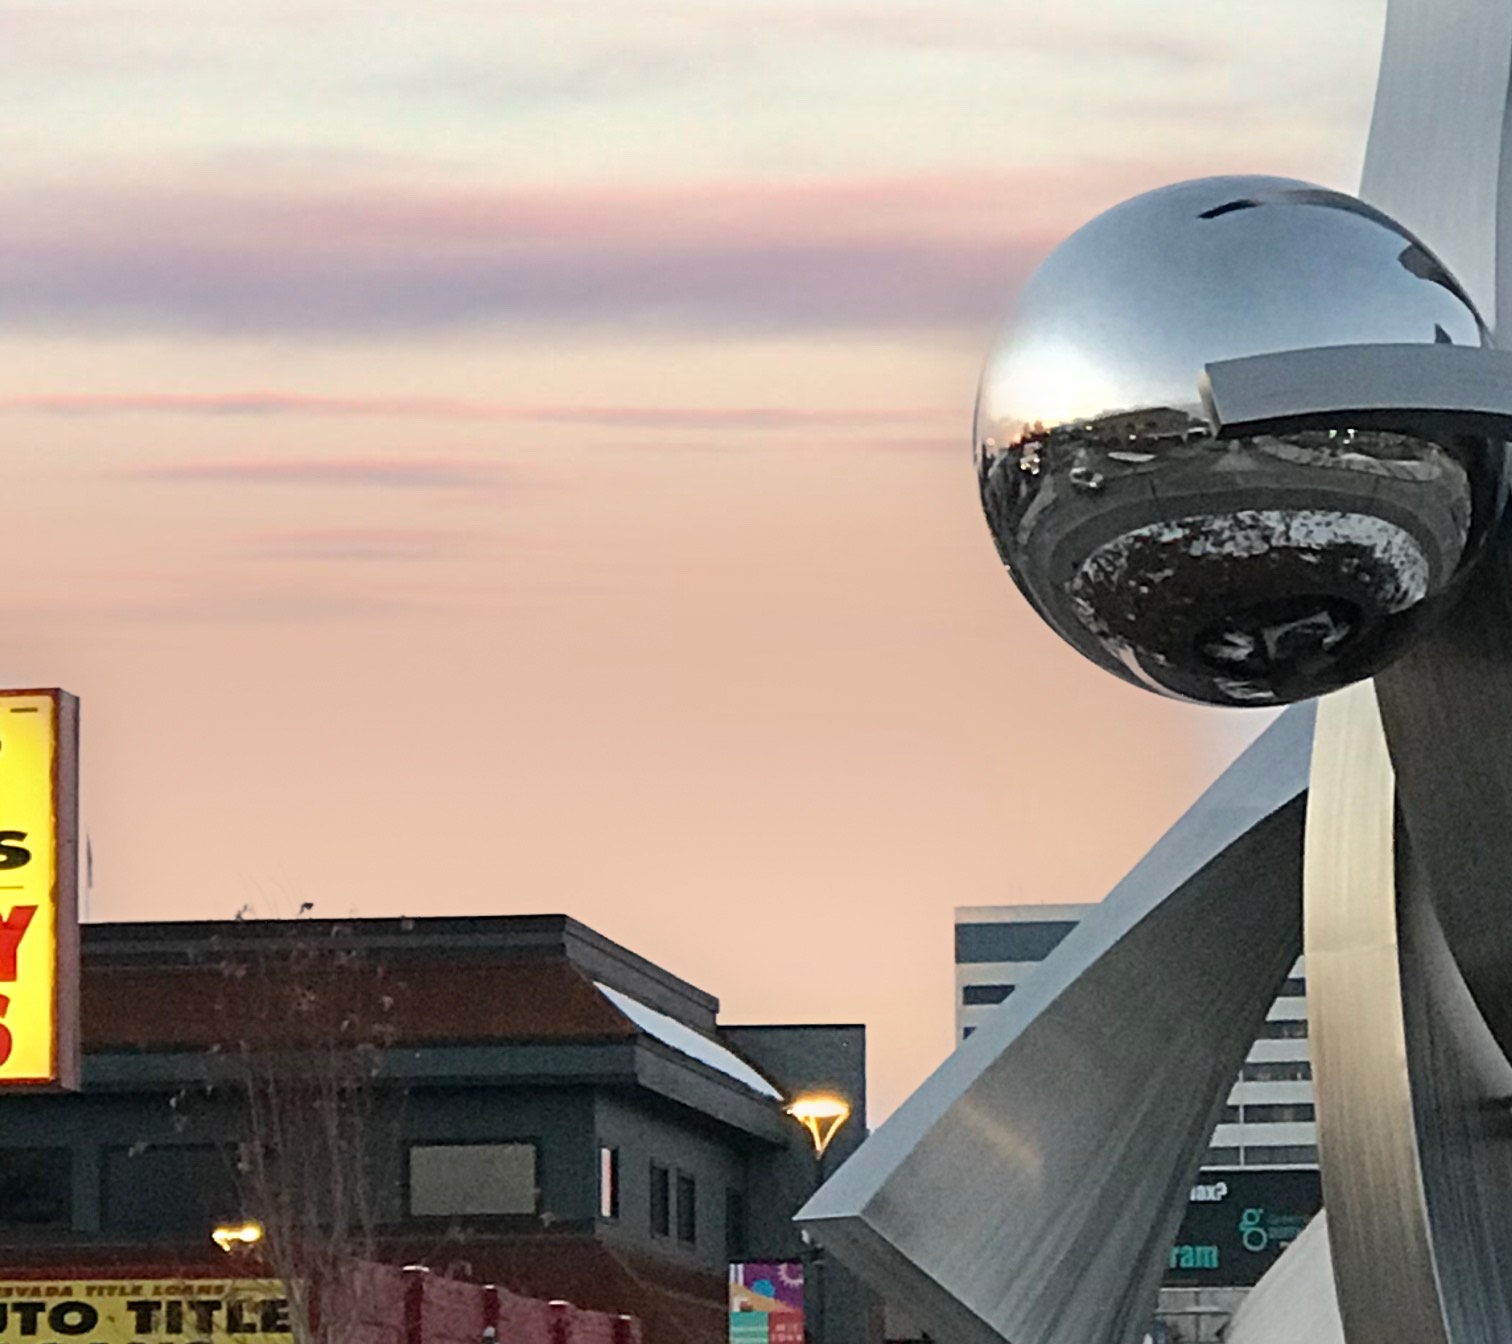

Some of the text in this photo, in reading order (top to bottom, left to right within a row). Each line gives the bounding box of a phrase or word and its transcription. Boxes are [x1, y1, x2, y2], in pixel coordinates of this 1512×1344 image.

[85, 1284, 144, 1297] TITLE
[152, 1284, 226, 1297] LOANS
[126, 1299, 290, 1335] TITLE
